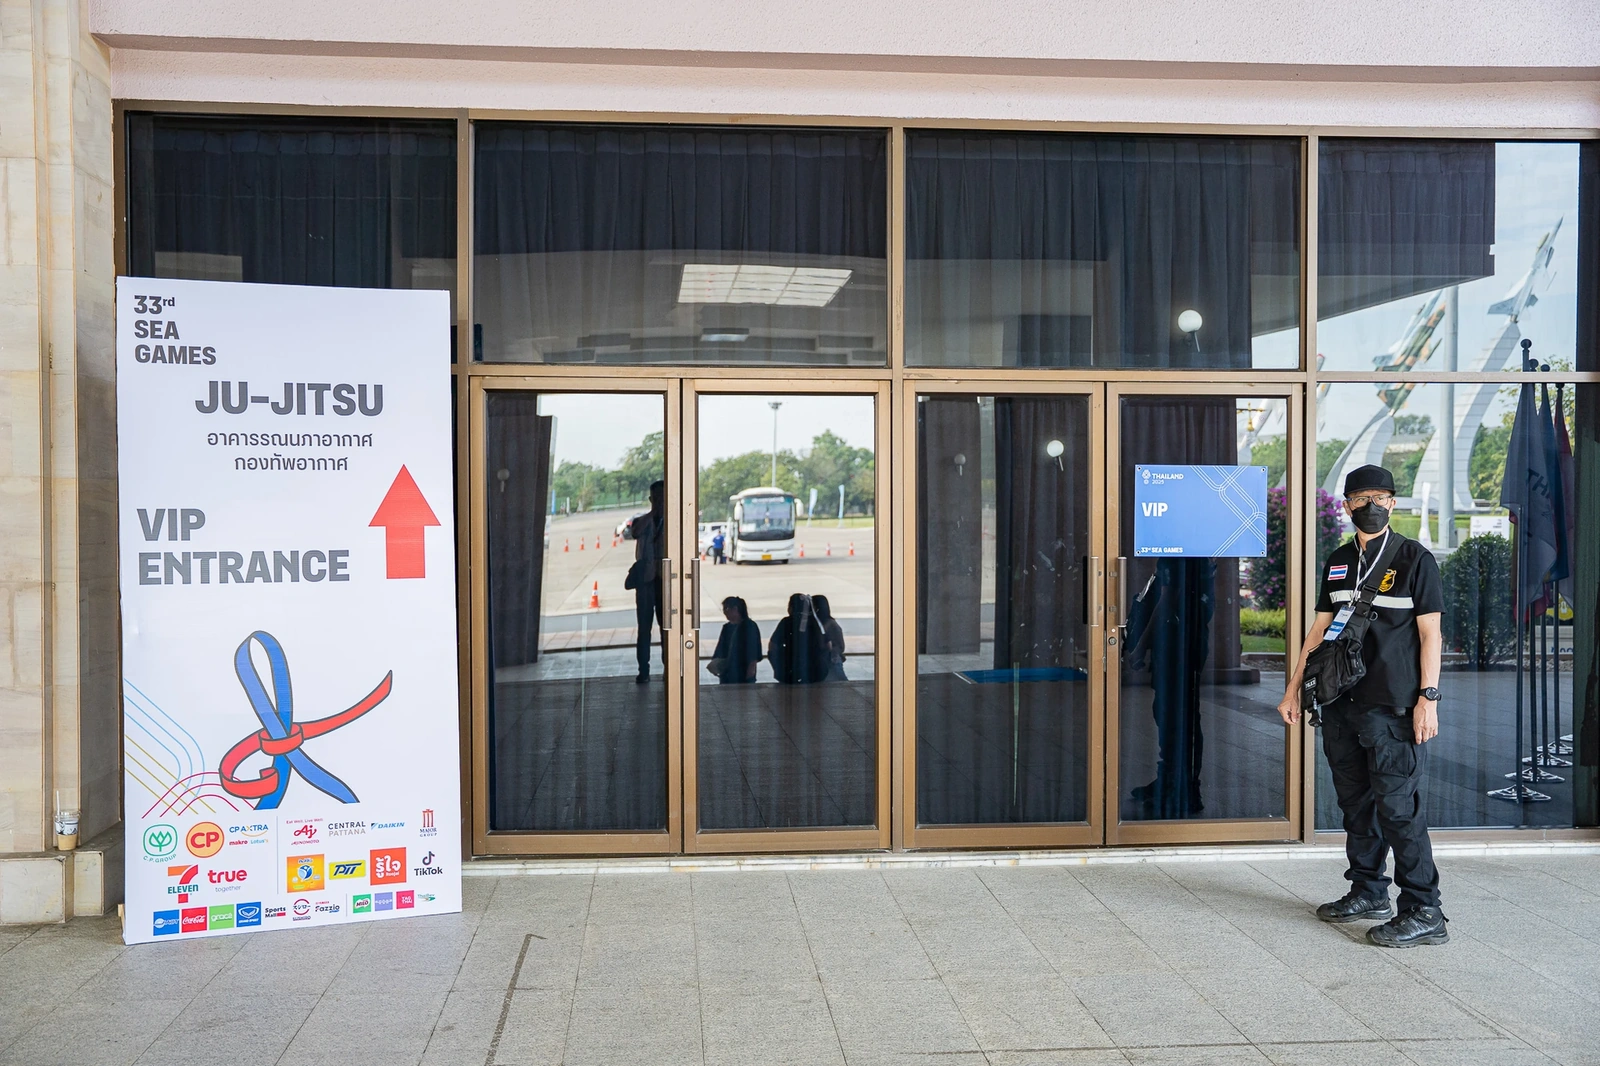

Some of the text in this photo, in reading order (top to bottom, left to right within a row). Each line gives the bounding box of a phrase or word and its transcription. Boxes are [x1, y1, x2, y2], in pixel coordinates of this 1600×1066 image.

[134, 294, 175, 314] 33rd
[134, 320, 180, 340] SEA
[134, 344, 217, 365] GAMES
[195, 380, 384, 416] JU-JITSU
[207, 431, 373, 447] อาคารรณนภาอากาศ
[234, 453, 348, 471] กองทัพอากาศ
[1142, 502, 1168, 517] VIP
[136, 508, 206, 541] VIP
[138, 549, 350, 585] ENTRANCE
[241, 824, 269, 832] AXTRA
[328, 821, 366, 830] CENTRAL
[328, 828, 366, 837] PATTANA
[190, 831, 220, 849] CP
[333, 863, 363, 876] PTT
[375, 854, 402, 879] รู้ใจ
[414, 866, 443, 876] TikTok
[207, 869, 248, 884] true
[215, 885, 241, 893] together
[315, 904, 340, 912] Fazzio
